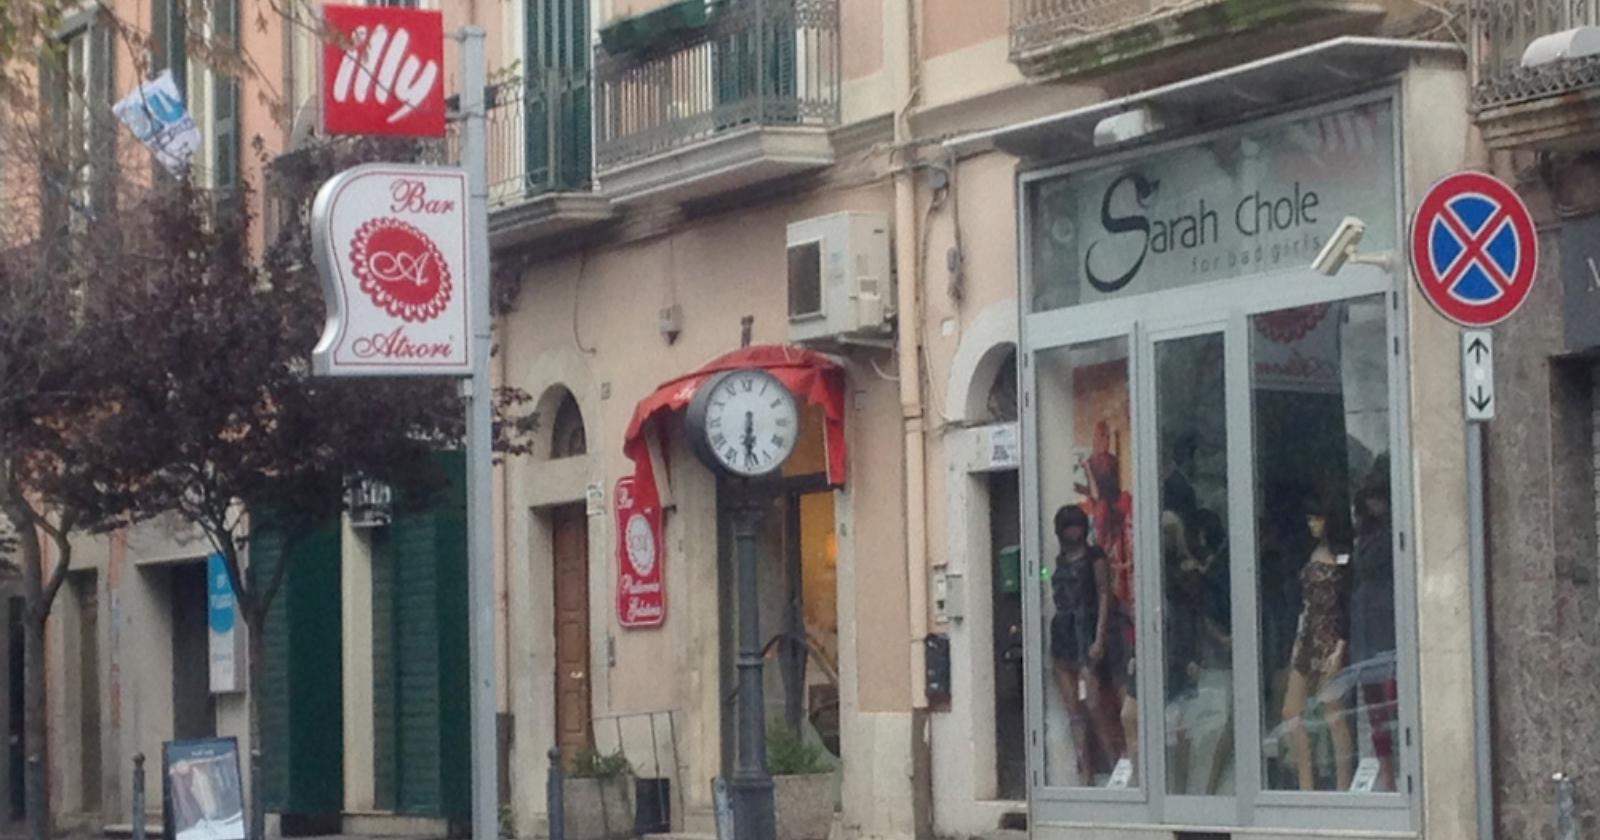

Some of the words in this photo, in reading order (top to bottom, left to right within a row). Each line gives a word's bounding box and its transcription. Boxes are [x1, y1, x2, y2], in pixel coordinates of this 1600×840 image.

[333, 24, 438, 123] illy
[390, 178, 455, 214] Bar
[1085, 173, 1219, 292] Sarah
[1235, 181, 1319, 237] Chole
[352, 326, 454, 359] Atzori
